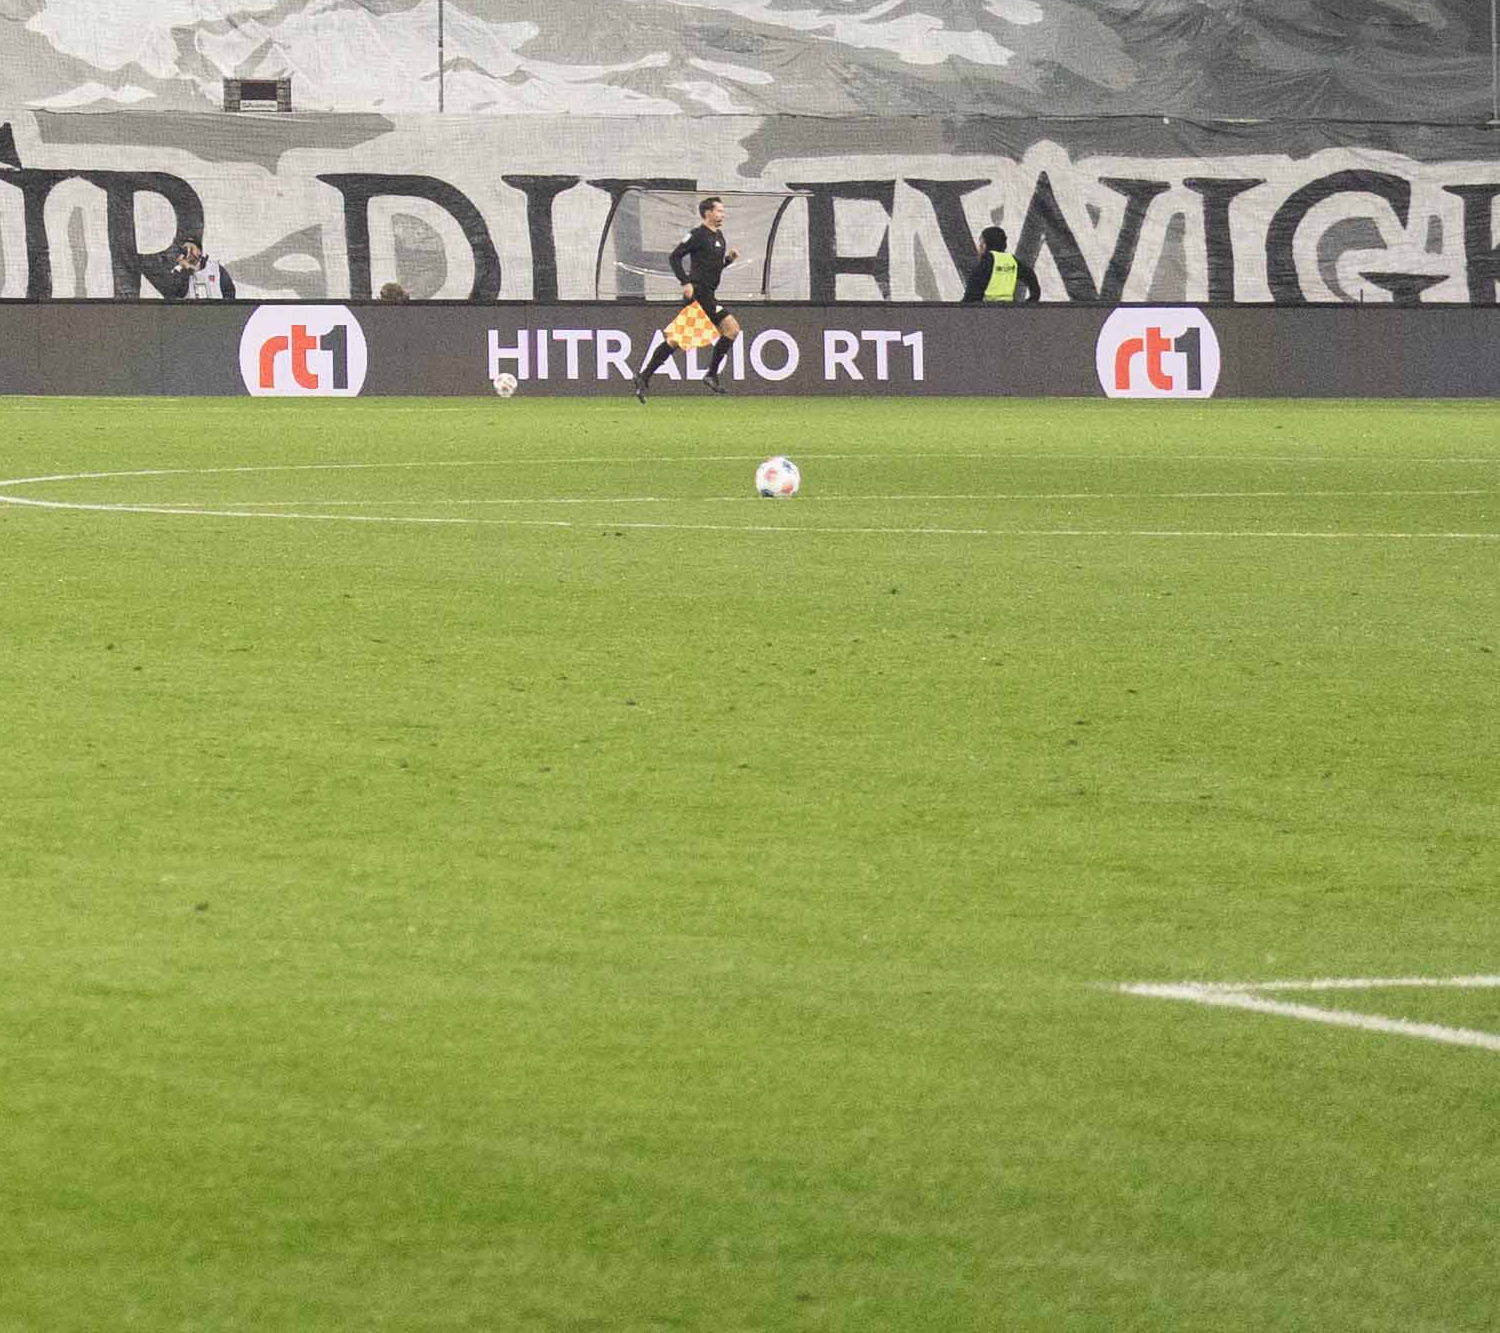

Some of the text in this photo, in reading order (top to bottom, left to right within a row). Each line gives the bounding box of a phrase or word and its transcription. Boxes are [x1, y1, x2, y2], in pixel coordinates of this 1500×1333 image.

[259, 324, 348, 390] rt1
[823, 330, 925, 382] RT1
[1115, 326, 1204, 391] rt1
